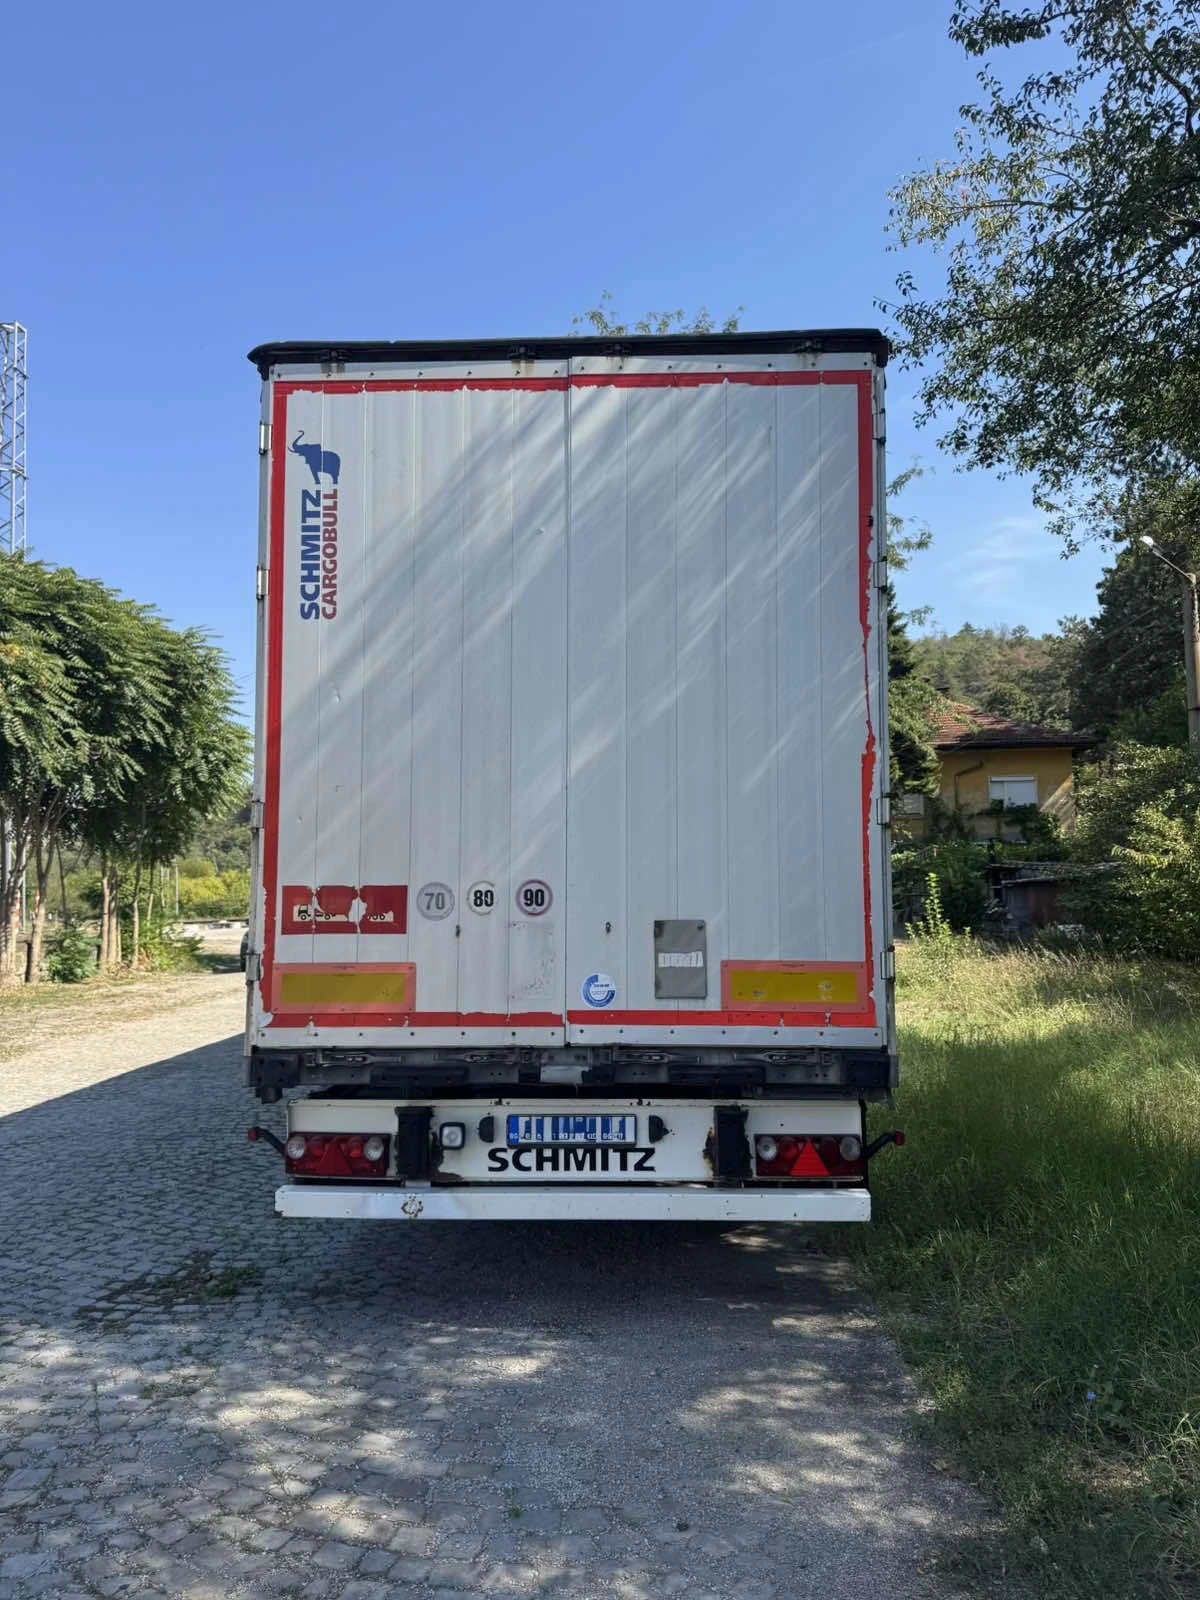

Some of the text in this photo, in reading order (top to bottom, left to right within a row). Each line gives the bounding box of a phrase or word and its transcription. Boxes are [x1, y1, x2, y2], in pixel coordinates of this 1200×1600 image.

[300, 489, 321, 620] SCHMITZ
[322, 489, 338, 619] CARGOBULL
[425, 893, 446, 910] 70
[473, 890, 494, 908] 80
[524, 889, 545, 907] 90
[487, 1147, 656, 1172] SCHMITZ
